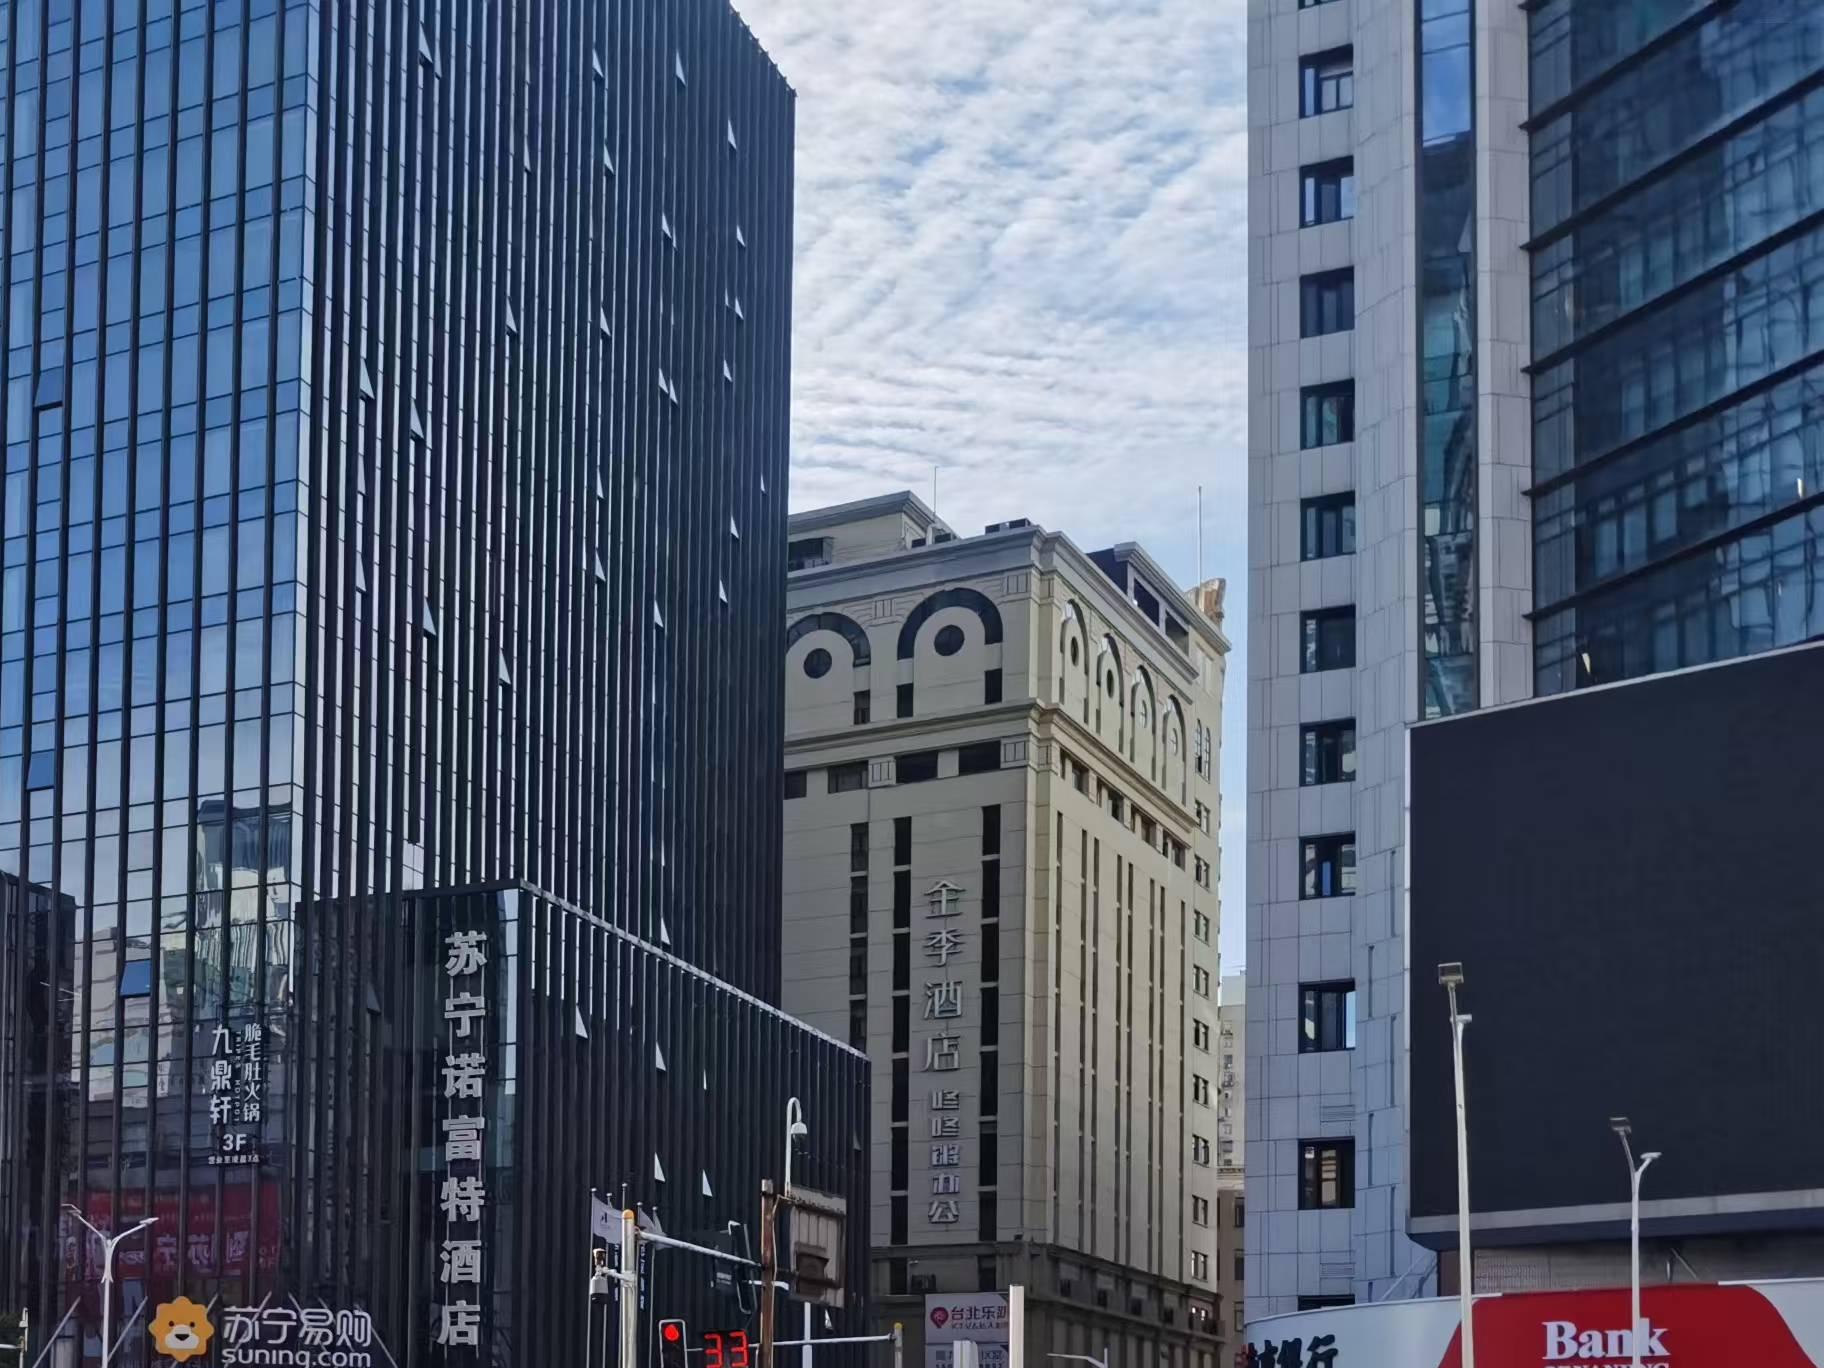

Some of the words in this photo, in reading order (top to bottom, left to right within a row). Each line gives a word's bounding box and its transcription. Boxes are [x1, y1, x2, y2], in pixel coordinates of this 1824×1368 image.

[209, 1023, 233, 1125] 九鼎轩
[243, 1022, 262, 1122] 脆毛肚火锅
[222, 1133, 247, 1151] 3F
[436, 930, 488, 1347] 苏宁诺富特酒店
[222, 1304, 372, 1348] 苏宁易购
[1541, 1317, 1672, 1360] Bank
